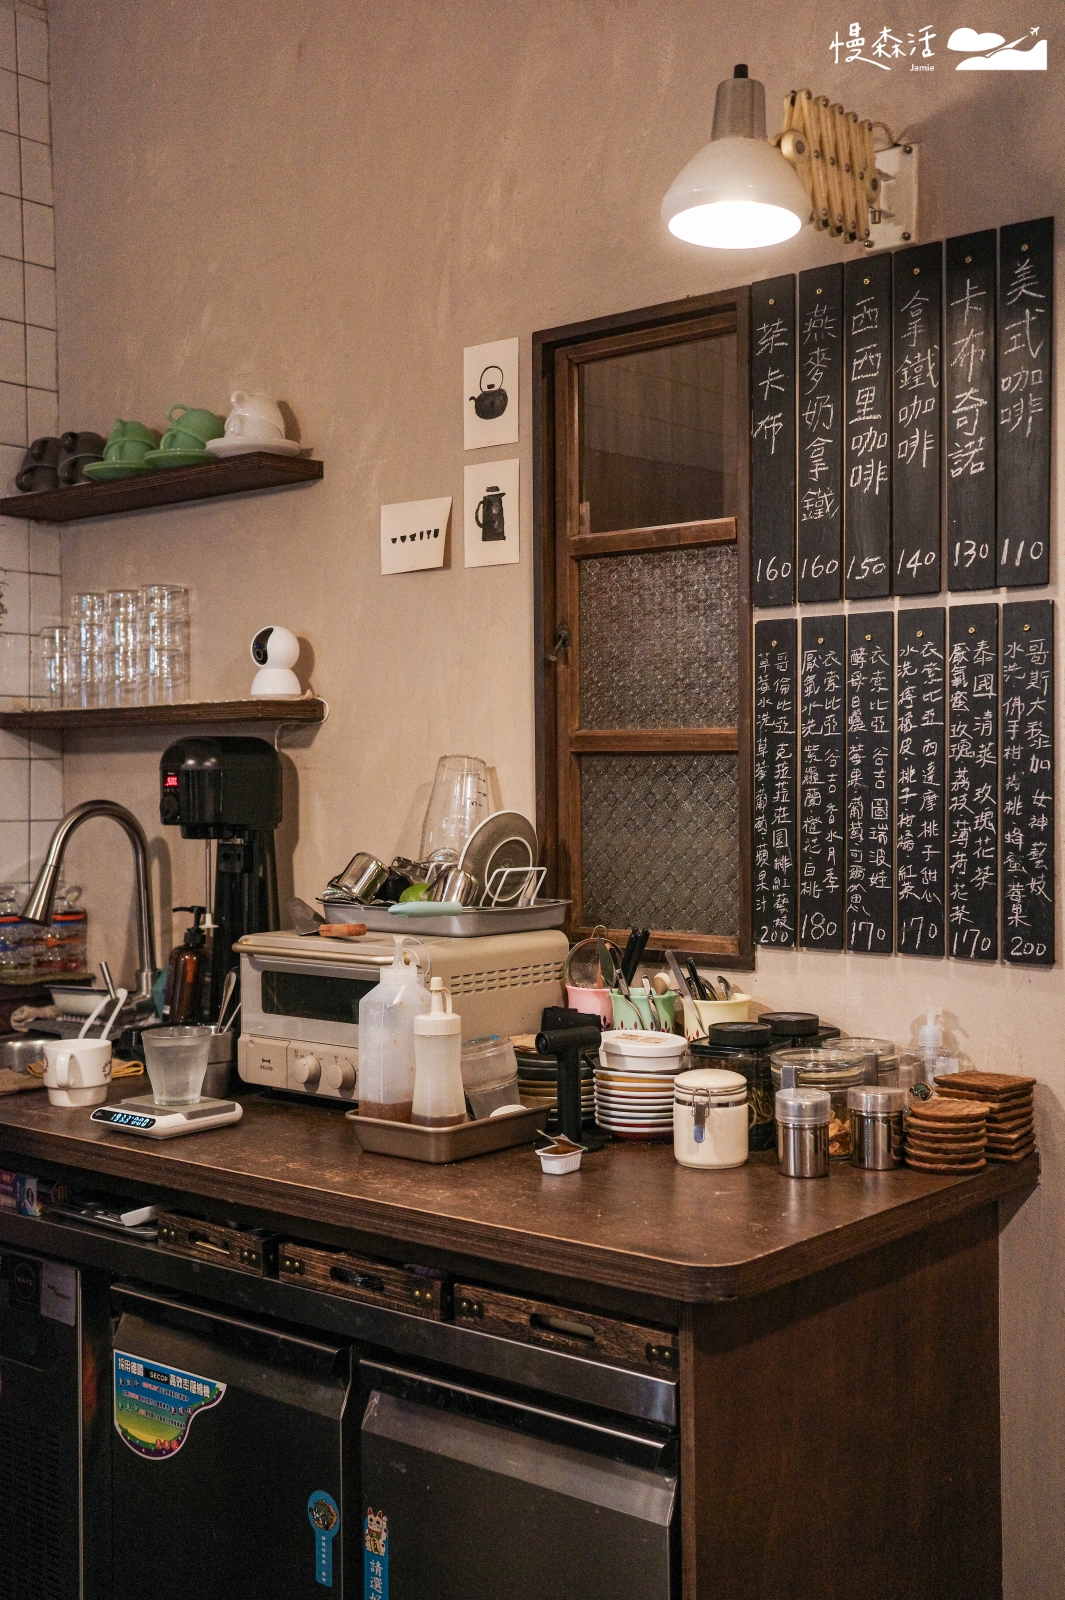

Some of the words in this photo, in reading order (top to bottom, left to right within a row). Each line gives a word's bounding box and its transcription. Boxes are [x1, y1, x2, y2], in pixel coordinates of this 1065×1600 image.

[1000, 258, 1046, 438] 美式咖啡
[896, 290, 940, 468] 拿鐵咖啡
[949, 279, 987, 477] 卡布奇諾
[849, 297, 888, 496] 西西里咖啡
[801, 304, 840, 522] 燕麥奶拿鐵
[896, 549, 936, 578] 140
[953, 540, 990, 568] 130
[1001, 538, 1045, 567] 110
[756, 556, 792, 583] 160
[801, 558, 839, 580] 160
[847, 556, 887, 580] 150
[760, 926, 789, 943] 200
[801, 912, 837, 940] 180
[850, 921, 886, 950] 170
[901, 917, 938, 950] 170
[952, 929, 991, 958] 170
[1011, 936, 1047, 957] 200
[149, 1371, 169, 1382] SECOP
